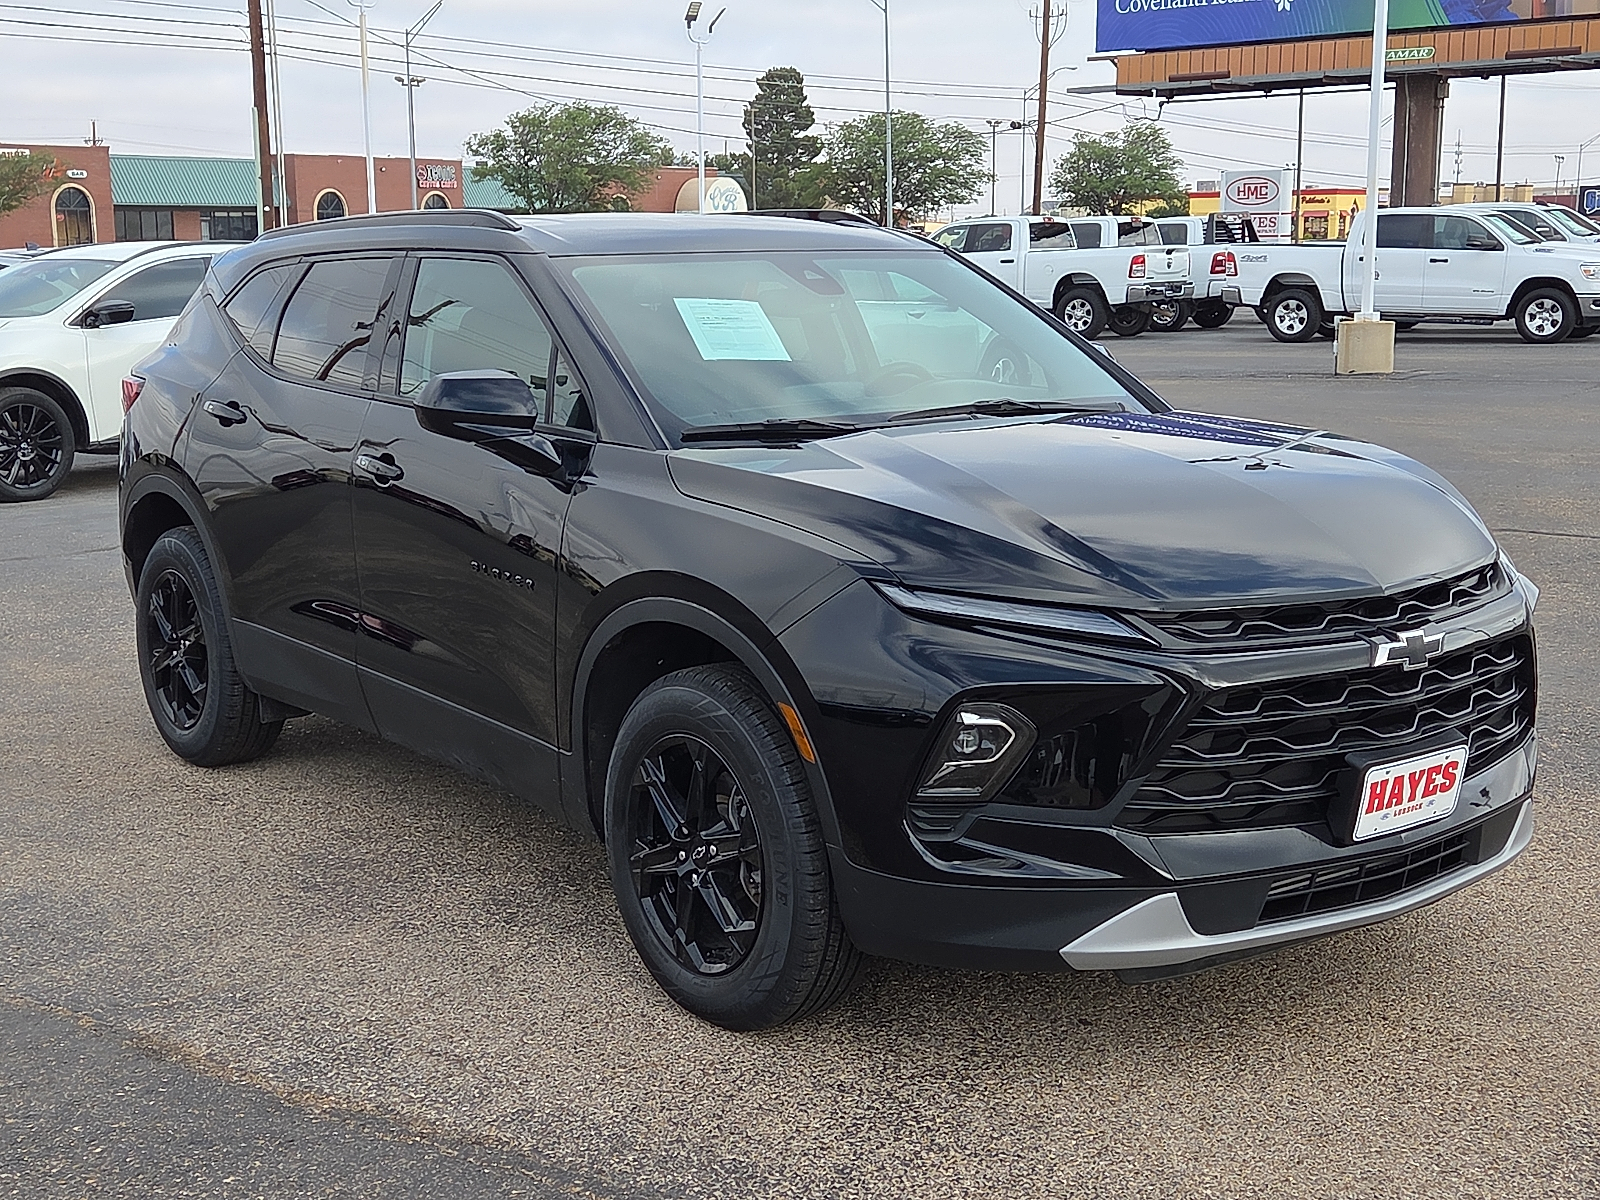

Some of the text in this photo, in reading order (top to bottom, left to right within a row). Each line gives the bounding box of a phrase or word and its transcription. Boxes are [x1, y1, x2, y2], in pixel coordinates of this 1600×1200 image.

[1387, 50, 1429, 59] AMAR
[1237, 182, 1268, 200] HMC
[470, 560, 536, 591] BLAZER
[1365, 761, 1459, 815] HAYES
